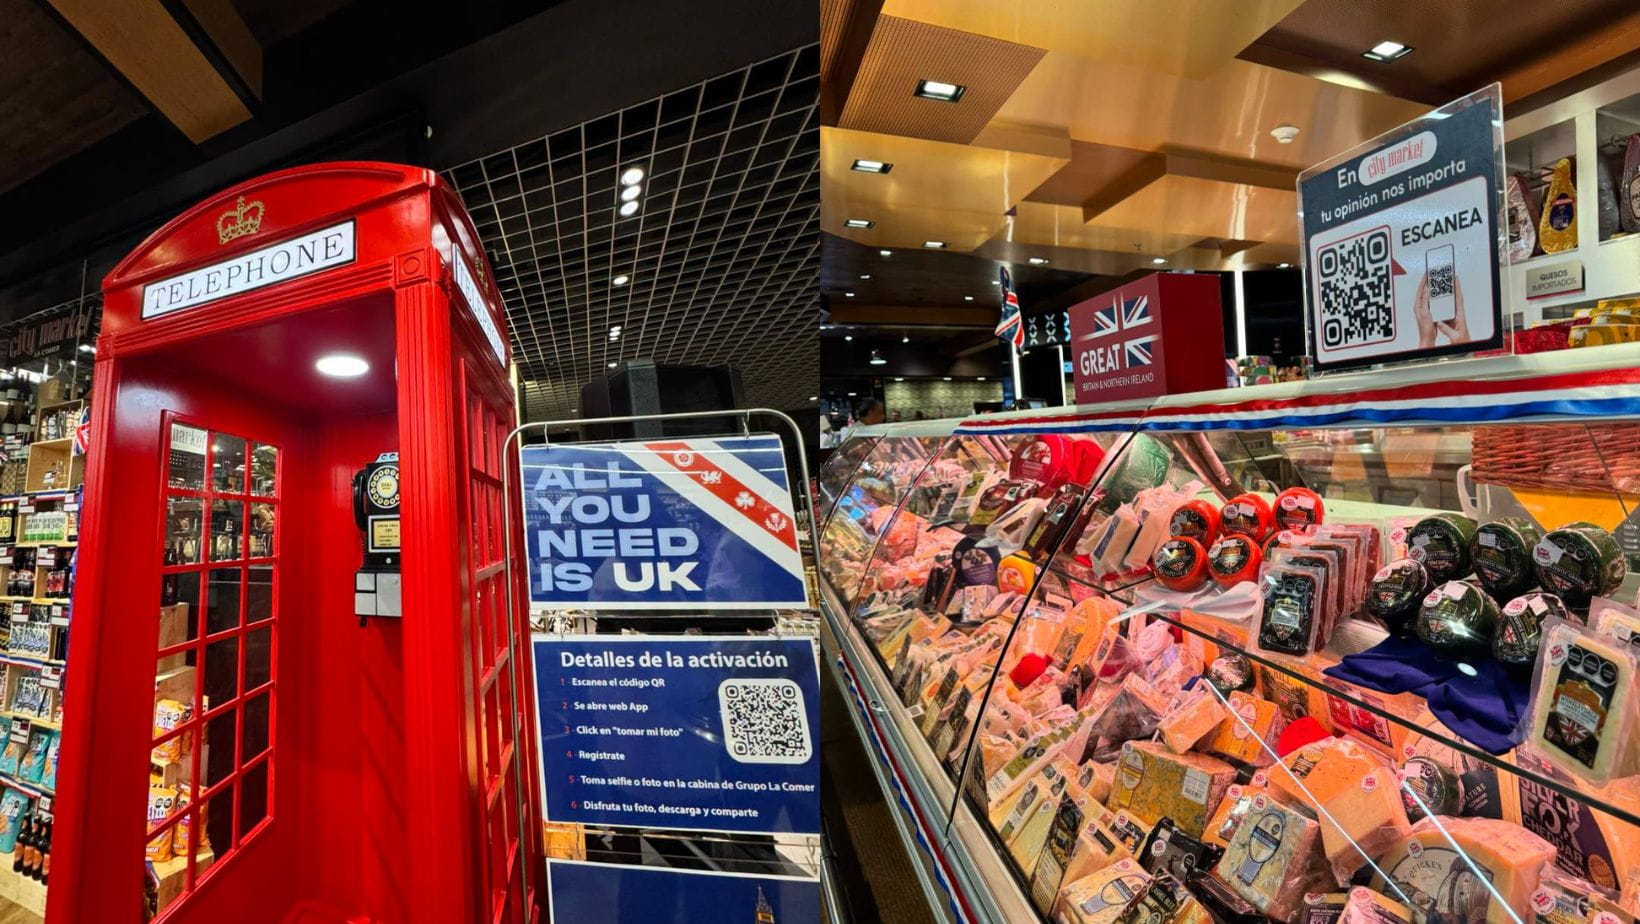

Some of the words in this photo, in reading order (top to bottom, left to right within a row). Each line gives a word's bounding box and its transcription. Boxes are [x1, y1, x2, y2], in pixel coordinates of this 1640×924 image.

[1337, 168, 1357, 189] En
[1367, 155, 1386, 179] city
[1388, 138, 1424, 168] market
[1321, 209, 1332, 223] tu
[1334, 192, 1378, 220] opinión
[1382, 184, 1405, 200] nos
[1408, 159, 1466, 191] importa
[1401, 207, 1483, 247] ESCANEA
[151, 231, 345, 309] TELEPHONE
[1540, 270, 1568, 281] QUESOS
[1080, 343, 1120, 376] GREAT
[1103, 376, 1130, 388] NORTHERN
[1131, 371, 1154, 385] IRELAND
[534, 461, 643, 490] ALL
[536, 494, 650, 524] YOU
[538, 528, 699, 558] NEED
[541, 562, 593, 592] IS
[613, 562, 702, 592] UK
[561, 651, 635, 667] Detalles
[639, 651, 662, 667] de
[666, 651, 684, 667] la
[688, 651, 789, 668] activación
[572, 678, 608, 686] Escanea
[609, 678, 618, 686] el
[619, 678, 650, 688] código
[651, 678, 665, 687] QR
[574, 701, 585, 710] Se
[586, 702, 607, 710] abre
[608, 702, 628, 711] web
[629, 702, 648, 712] App
[576, 725, 599, 734] Click
[600, 727, 611, 735] en
[612, 726, 644, 735] "tomar
[646, 727, 658, 736] mi
[660, 727, 683, 737] foto"
[580, 775, 606, 785] Toma
[607, 776, 632, 786] selfie
[641, 777, 661, 787] foto
[677, 778, 686, 788] la
[687, 779, 720, 789] cabina
[721, 780, 734, 790] de
[735, 780, 766, 792] Grupo
[768, 782, 780, 791] La
[782, 782, 815, 792] Comer
[1465, 783, 1487, 801] ATURE
[583, 800, 620, 811] Disfruta
[622, 802, 633, 811] tu
[634, 802, 657, 813] foto,
[658, 804, 702, 817] descarga
[703, 807, 709, 817] y
[711, 808, 759, 818] comparte
[1523, 815, 1583, 866] CHEDDAR
[1409, 861, 1442, 879] QUICKE'S
